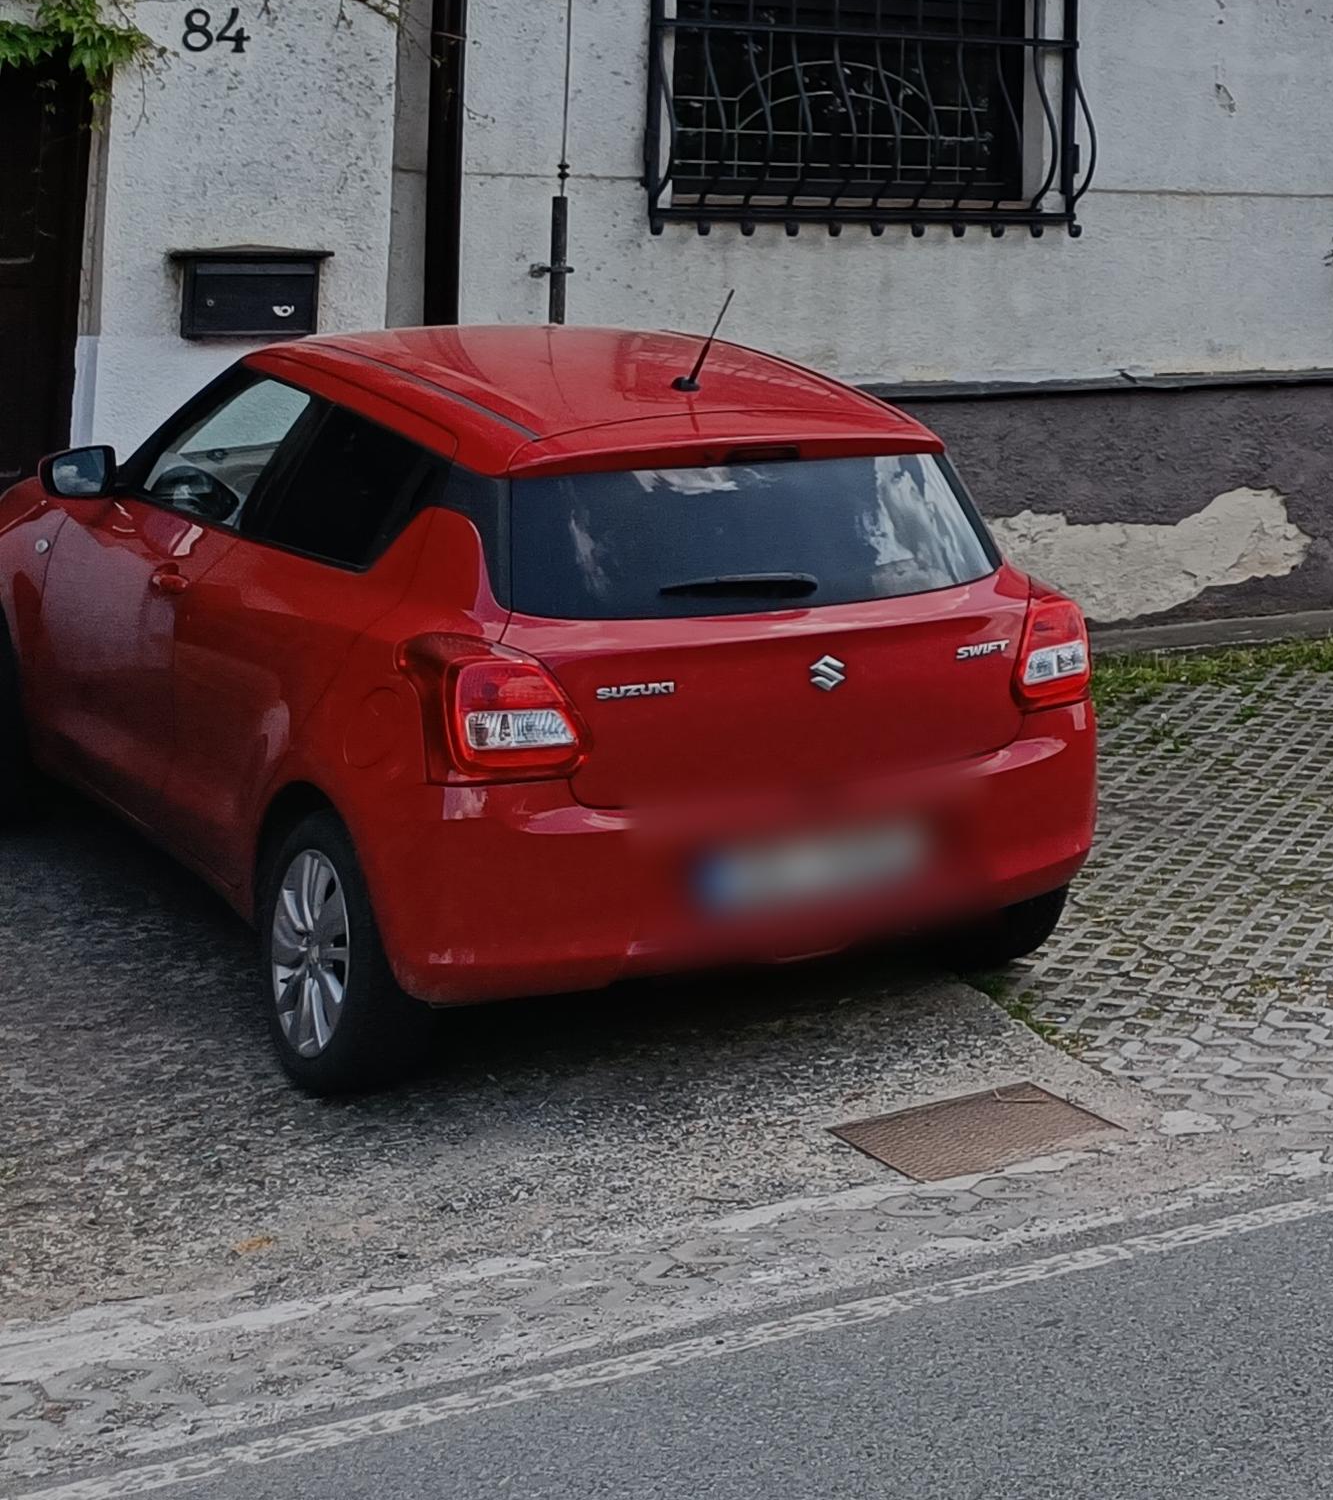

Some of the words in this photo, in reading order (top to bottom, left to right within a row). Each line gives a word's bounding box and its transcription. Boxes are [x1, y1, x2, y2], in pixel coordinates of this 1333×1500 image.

[182, 7, 251, 53] 84
[956, 639, 1011, 660] SWIFT
[596, 680, 675, 700] SUZUKI
